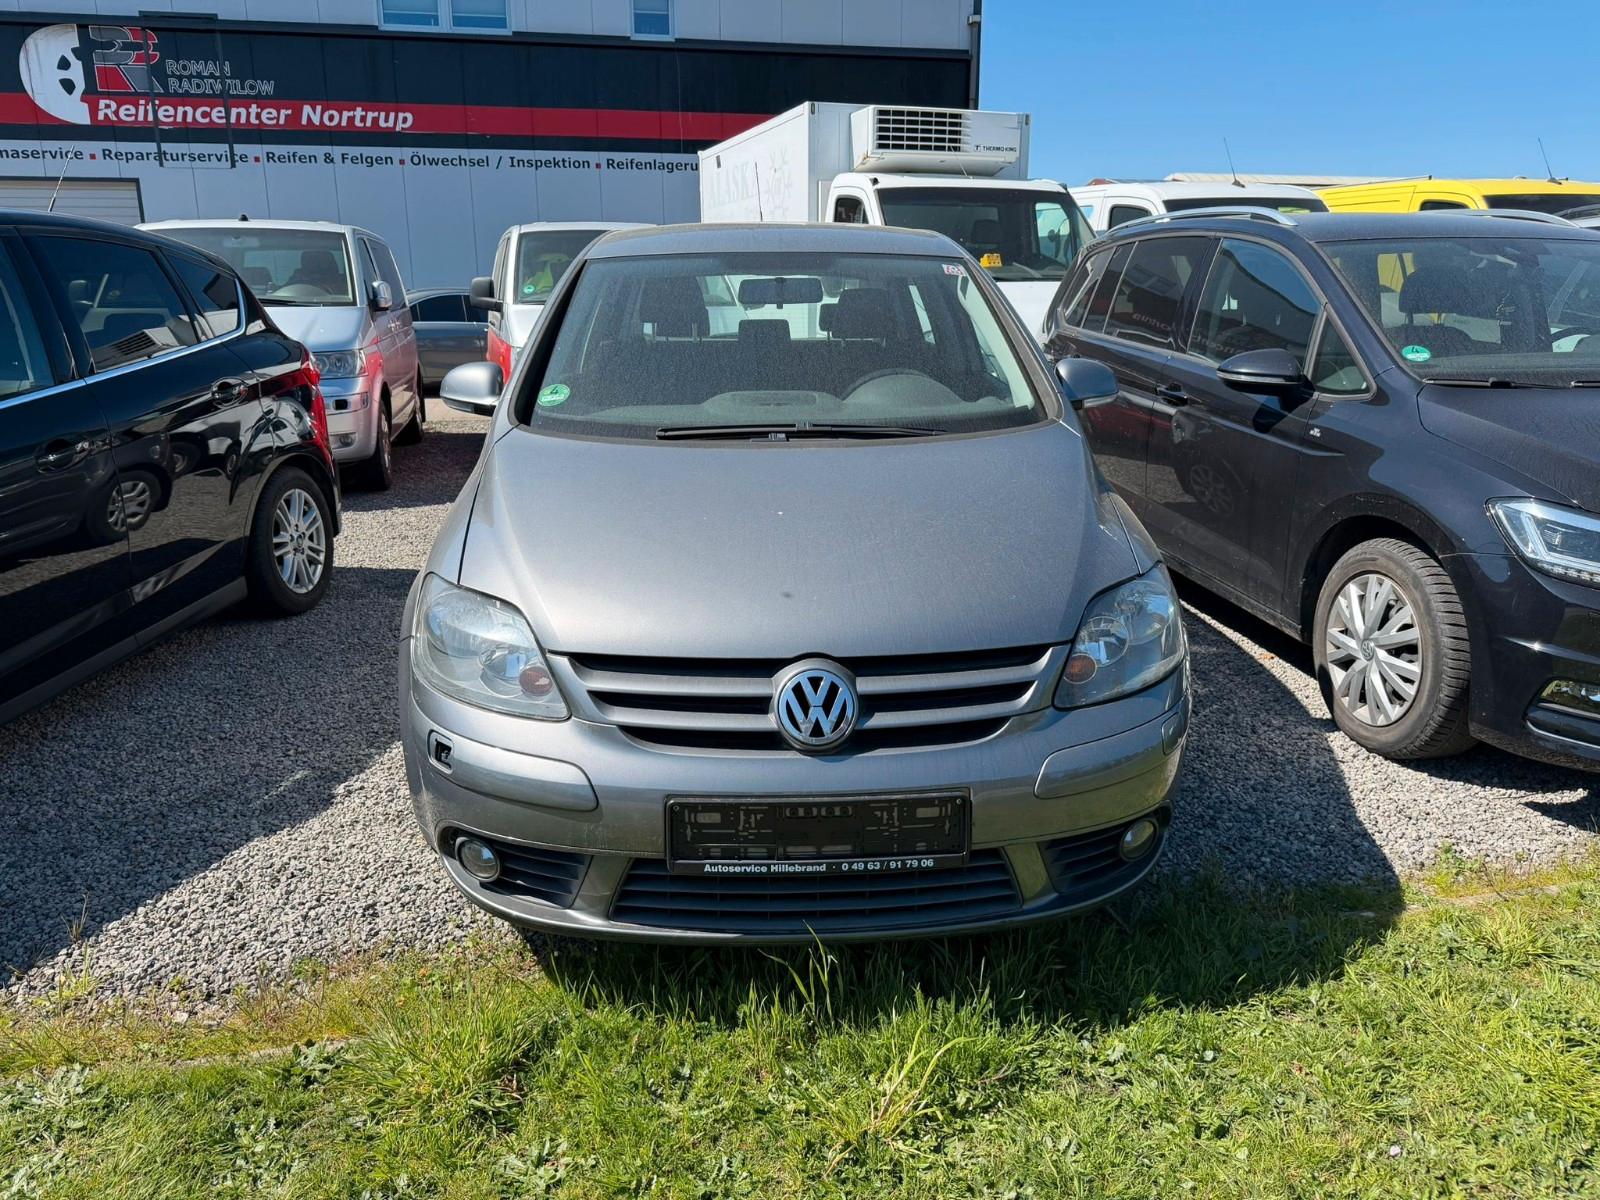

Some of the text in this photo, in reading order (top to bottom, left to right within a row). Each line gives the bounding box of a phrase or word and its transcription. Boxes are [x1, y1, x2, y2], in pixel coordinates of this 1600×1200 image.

[166, 59, 231, 76] ROMAN
[168, 78, 275, 96] RADIWILOW
[97, 99, 414, 131] Reifencenter Nortrup
[101, 148, 249, 164] Reparaturservice
[265, 151, 318, 164] Reifen
[323, 152, 335, 165] &
[341, 153, 394, 168] Felgen
[410, 151, 490, 168] Ölwechsel
[509, 156, 591, 171] Inspektion
[703, 863, 768, 873] Autoservice
[770, 863, 827, 873] Hillebrand
[841, 863, 849, 871] 0
[851, 862, 865, 871] 49
[867, 861, 881, 870] 63
[889, 860, 902, 869] 91
[905, 859, 919, 868] 79
[920, 858, 934, 867] 06
